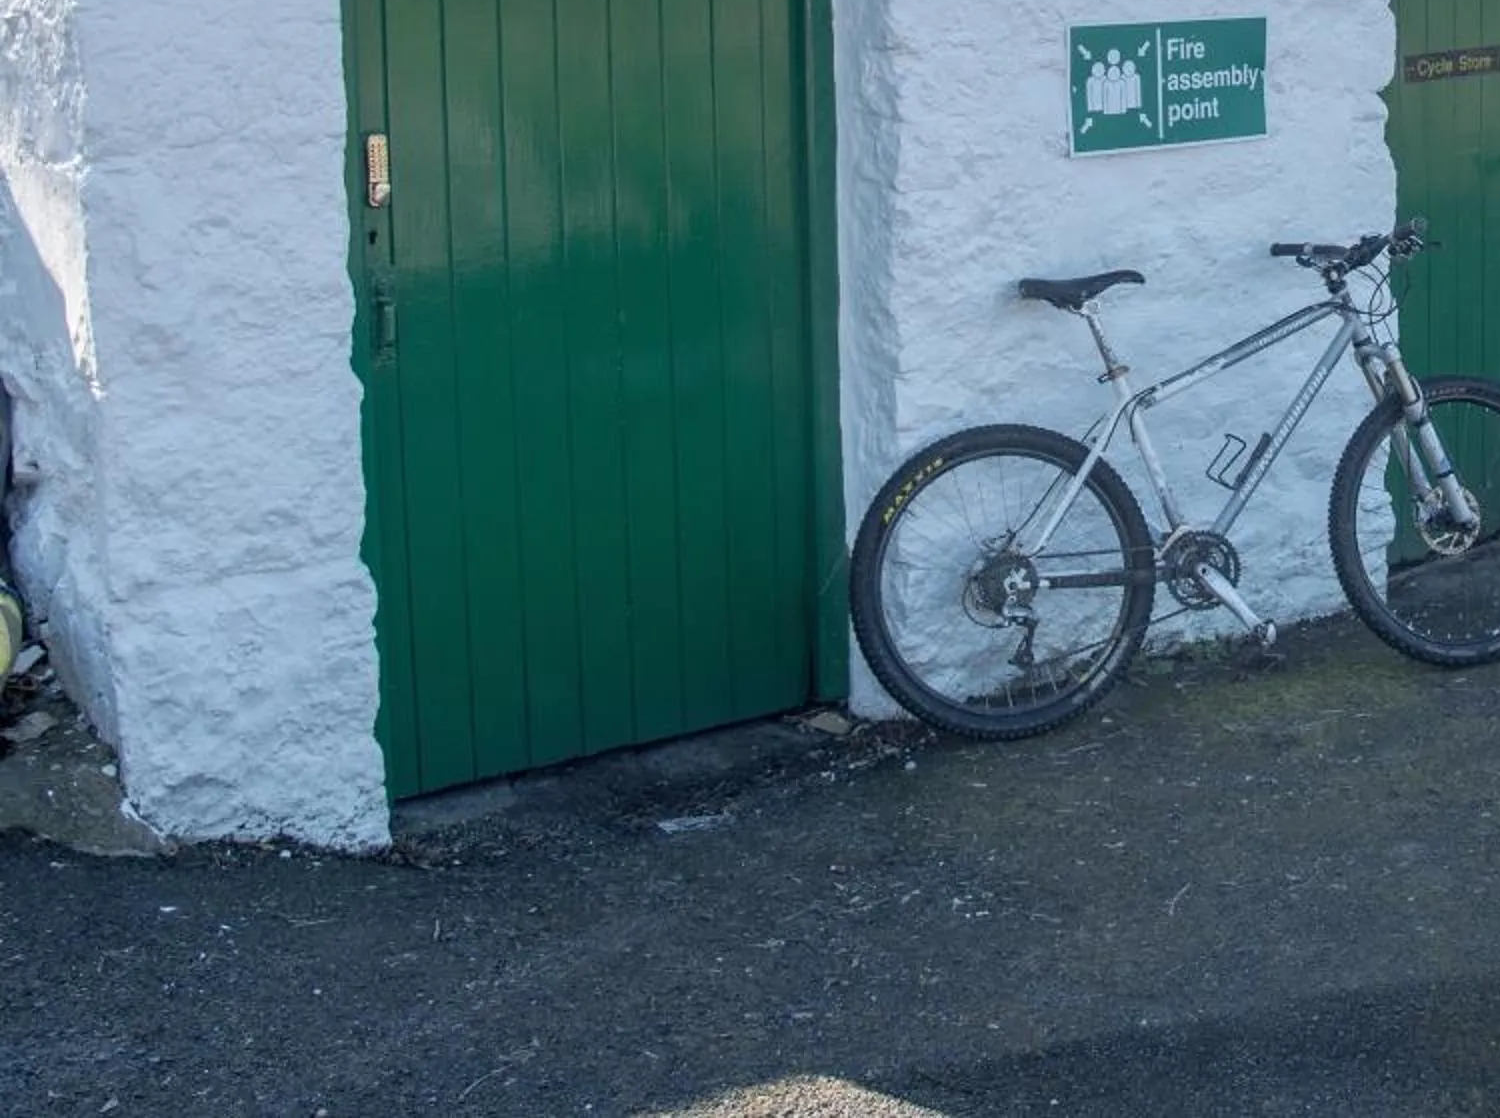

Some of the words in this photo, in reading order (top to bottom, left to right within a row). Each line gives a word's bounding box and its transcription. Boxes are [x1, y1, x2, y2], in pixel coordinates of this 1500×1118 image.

[1167, 36, 1205, 61] Fire
[1167, 63, 1259, 91] assembly
[1167, 97, 1220, 127] point
